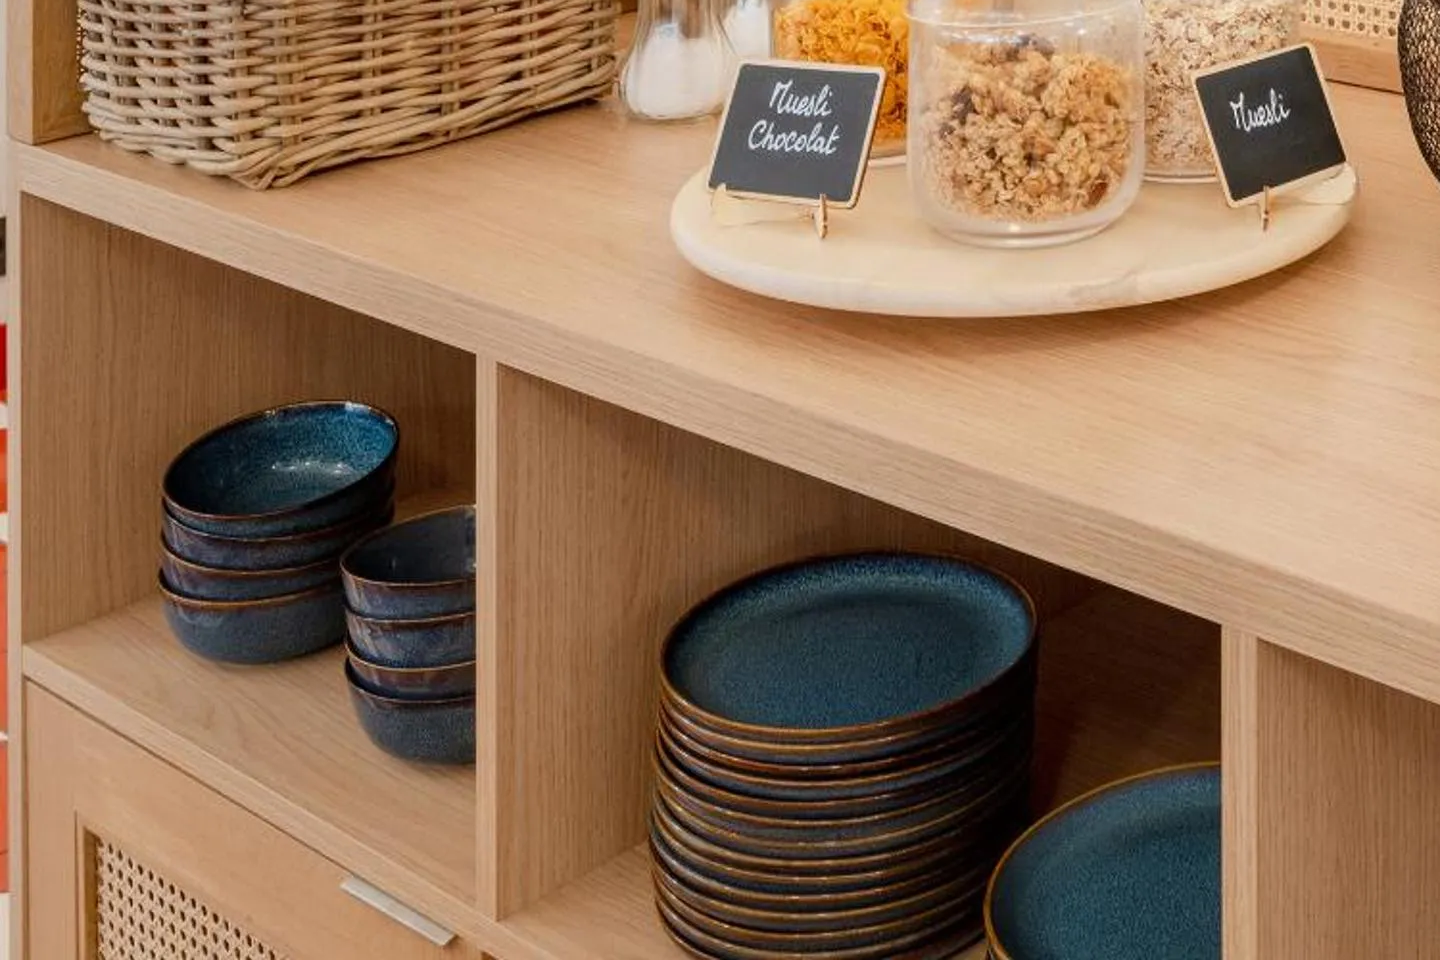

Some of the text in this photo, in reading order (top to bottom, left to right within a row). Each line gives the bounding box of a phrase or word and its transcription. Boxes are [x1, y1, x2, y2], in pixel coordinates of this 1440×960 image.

[768, 80, 833, 116] Muesli
[1229, 87, 1291, 132] Muesli
[747, 119, 841, 155] Chocolat
